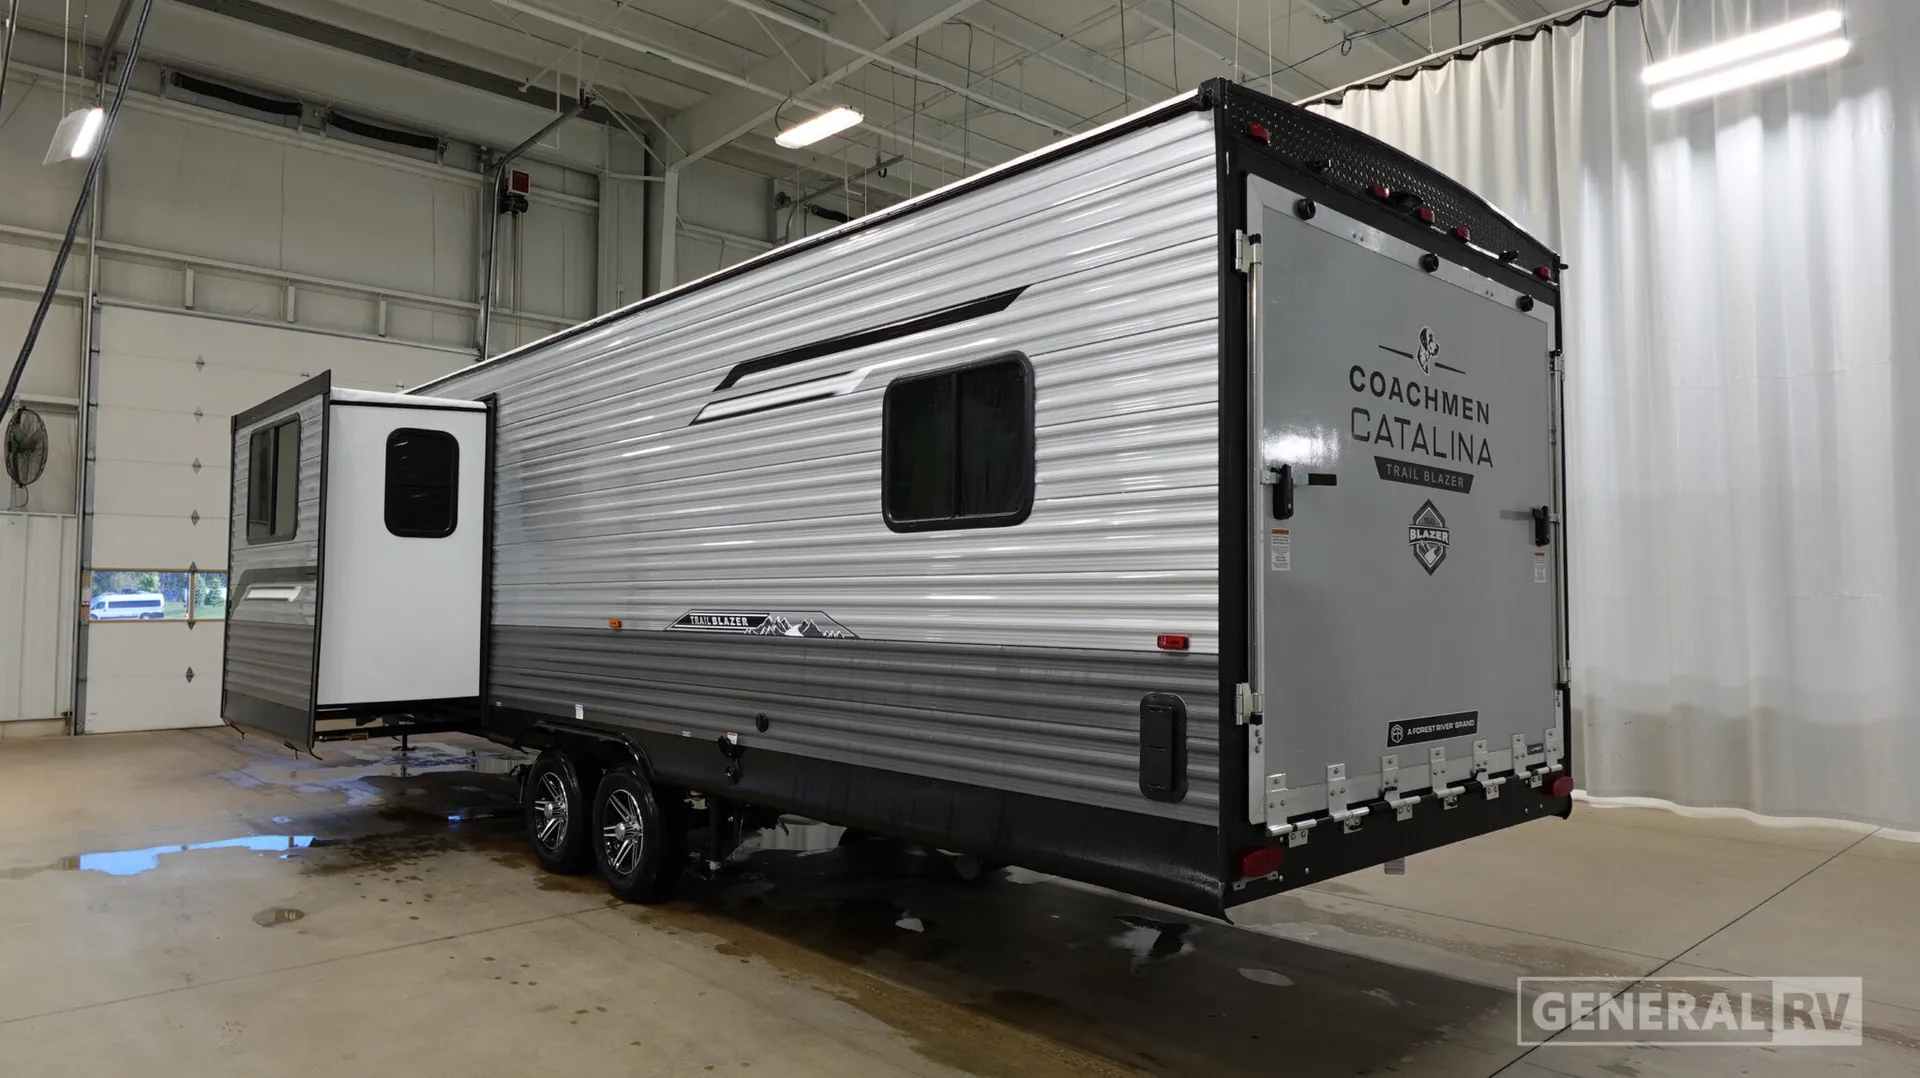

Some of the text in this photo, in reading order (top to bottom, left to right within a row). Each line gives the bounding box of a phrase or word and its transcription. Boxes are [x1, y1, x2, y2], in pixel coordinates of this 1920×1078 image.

[1349, 365, 1489, 425] COACHMEN
[1351, 407, 1493, 468] CATALINA
[1386, 463, 1464, 488] TRAIL BLAZER
[1409, 528, 1449, 544] BLAZER
[690, 616, 749, 626] TRAIL BLAZER
[1407, 728, 1412, 736] A
[1412, 724, 1436, 735] FOREST
[1454, 719, 1475, 729] BRAND
